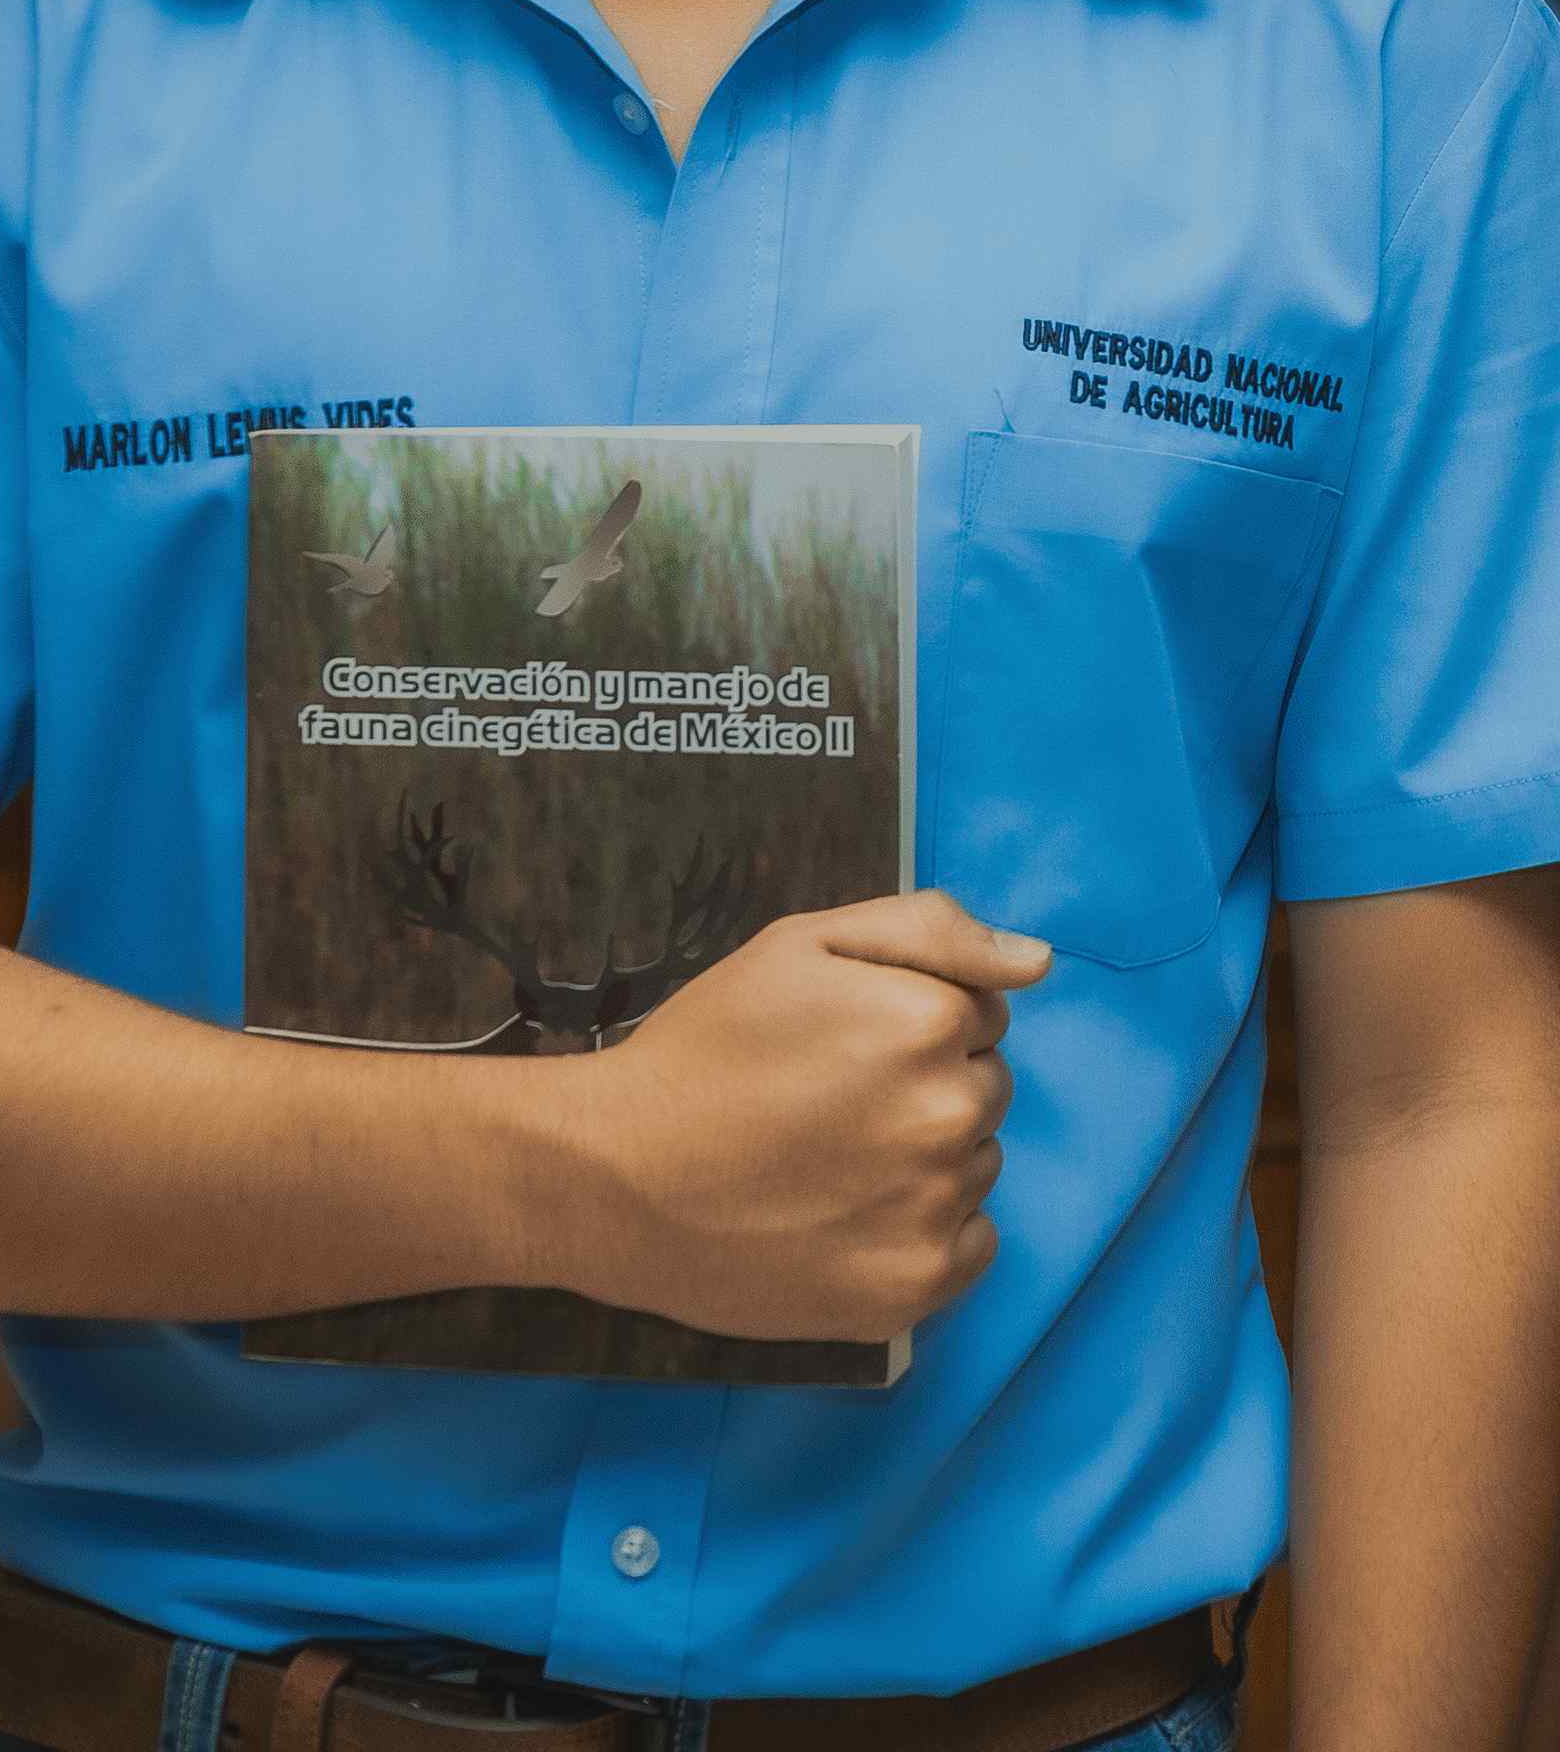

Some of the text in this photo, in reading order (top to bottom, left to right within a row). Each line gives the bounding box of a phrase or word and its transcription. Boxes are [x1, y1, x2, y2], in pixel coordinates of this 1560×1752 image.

[1023, 318, 1343, 413] UNIVERSIDAD NACIONAL
[1070, 370, 1294, 450] DE AGRICULTURA
[63, 416, 192, 472] MARLON
[323, 657, 829, 712] Conservación y manejo de
[300, 705, 854, 756] fauna cinegética de México II
